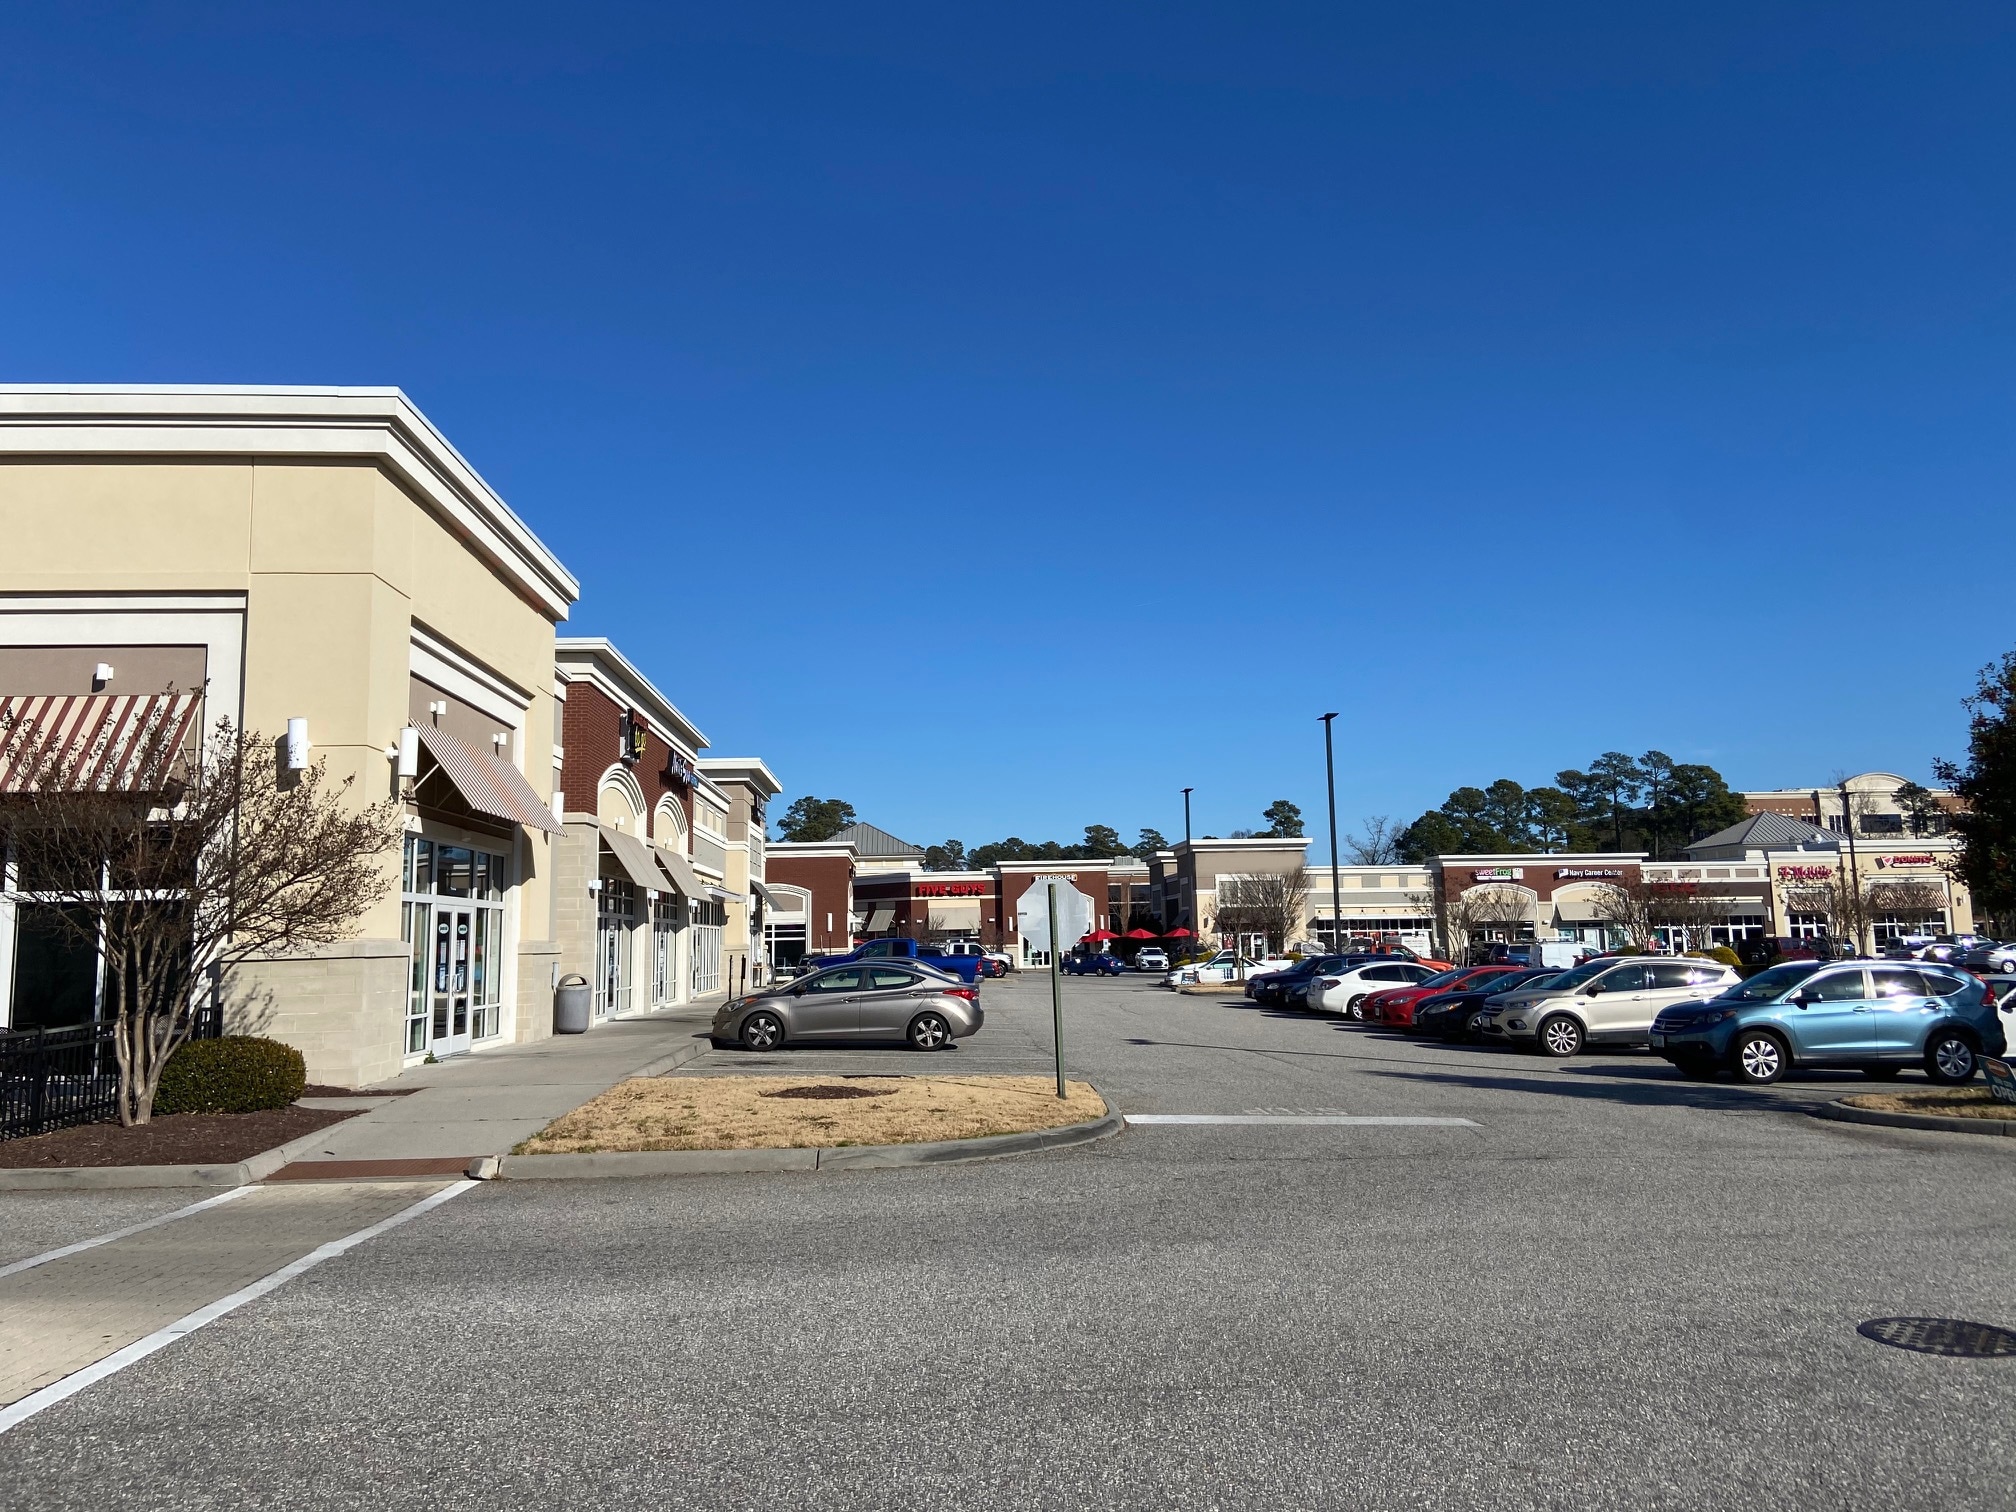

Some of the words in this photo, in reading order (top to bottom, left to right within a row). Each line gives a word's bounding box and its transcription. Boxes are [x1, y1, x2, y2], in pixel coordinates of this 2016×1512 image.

[1034, 874, 1077, 882] FIREHOUSE
[1569, 869, 1584, 878] Navy
[1604, 868, 1623, 876] Center
[918, 884, 947, 894] FIVE
[950, 884, 986, 894] GUYS
